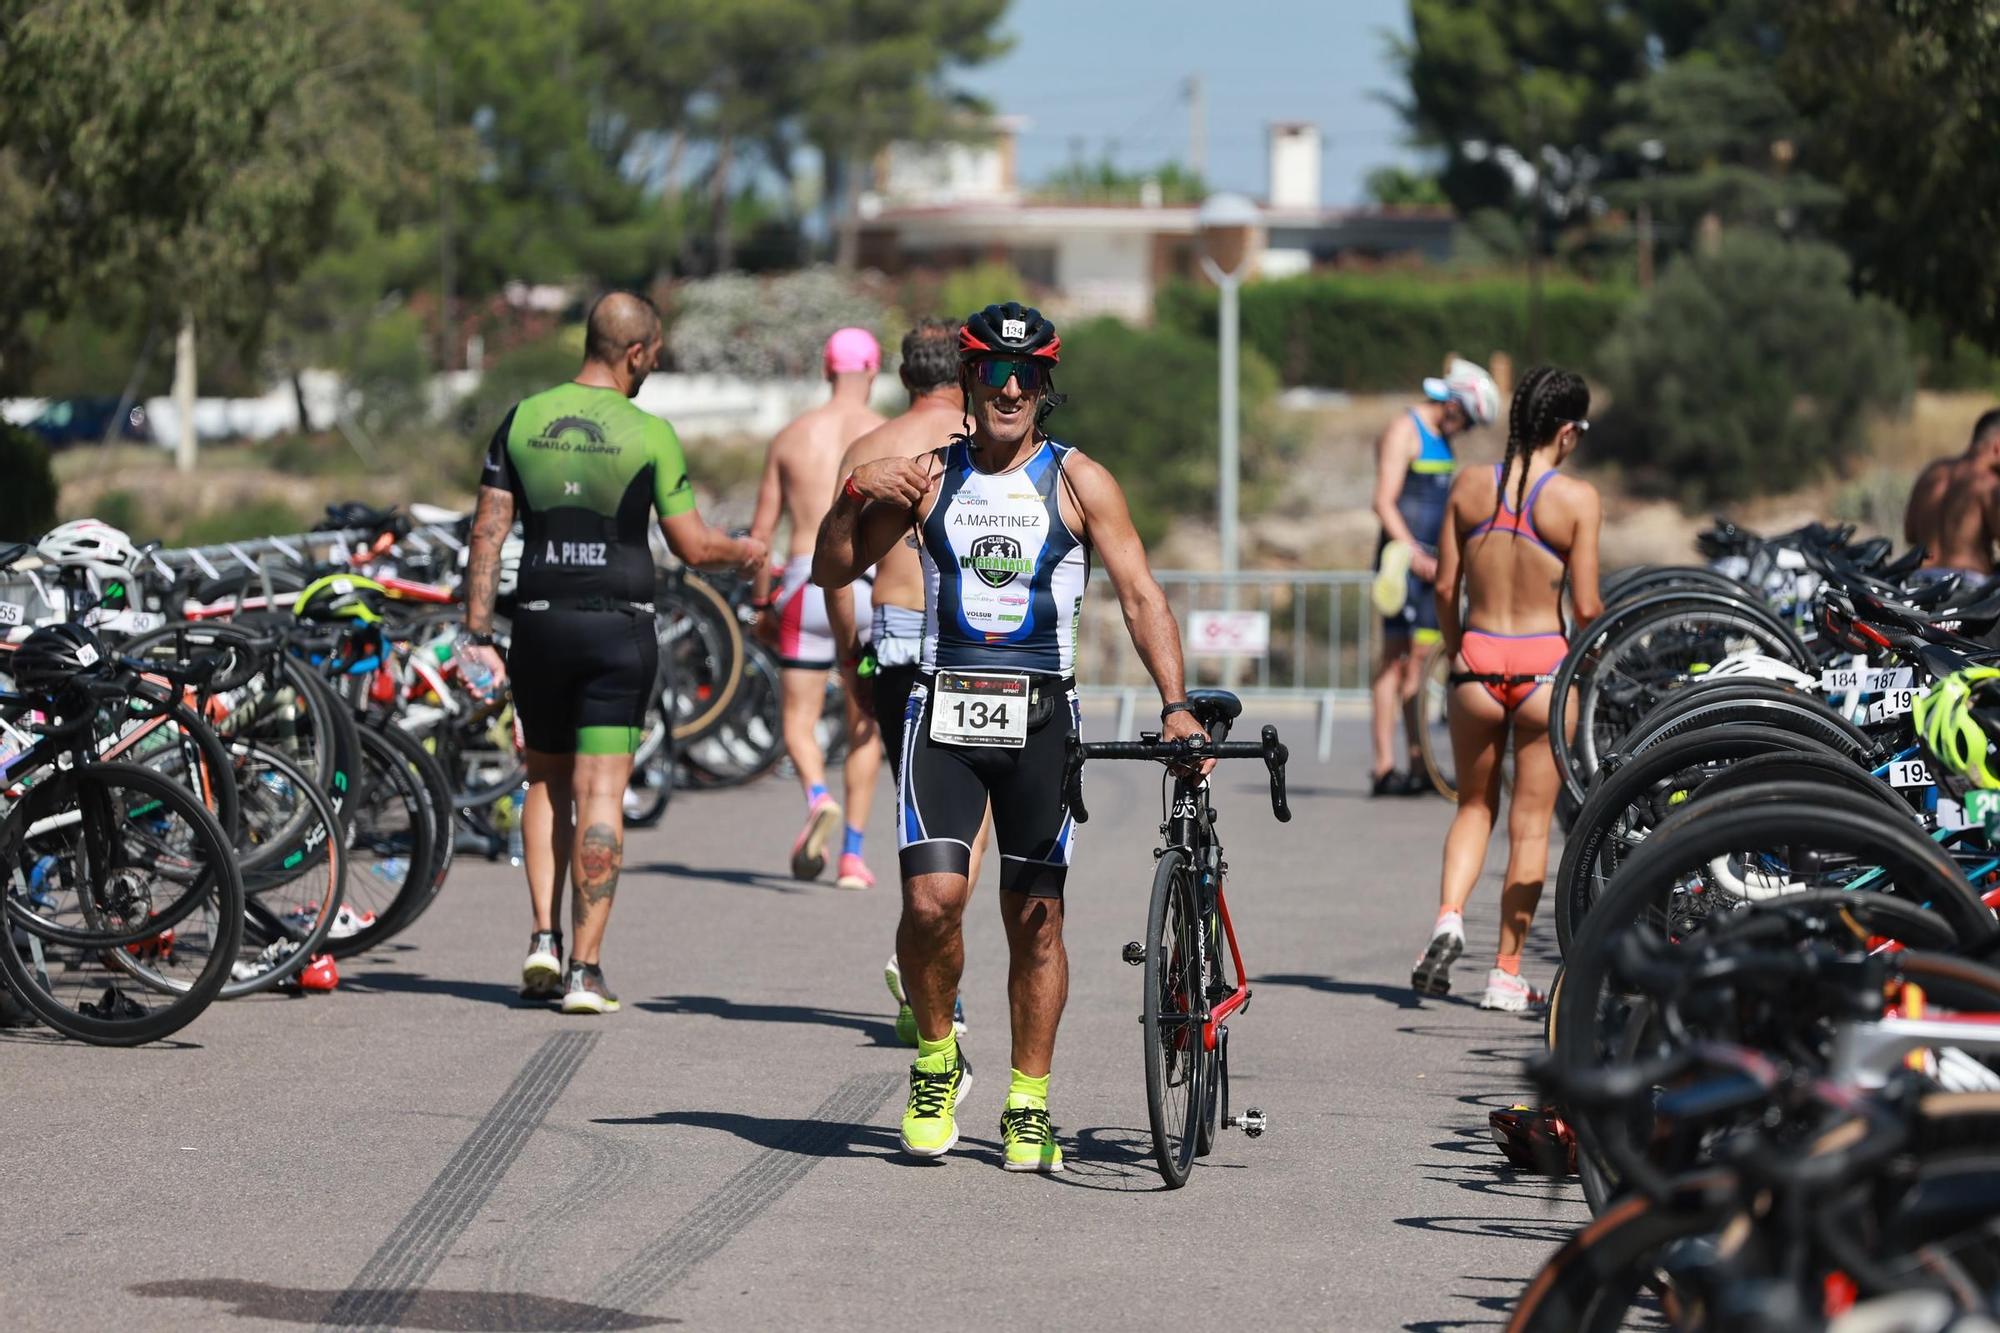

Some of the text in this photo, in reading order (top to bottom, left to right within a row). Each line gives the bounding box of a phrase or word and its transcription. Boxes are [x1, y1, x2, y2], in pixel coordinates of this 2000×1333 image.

[1005, 326, 1023, 336] 134
[953, 513, 1040, 528] A.MARTINEZ
[987, 536, 1005, 544] CLUB
[545, 540, 559, 565] A.
[132, 614, 149, 632] 50
[1831, 672, 1857, 687] 184
[1873, 672, 1897, 690] 187
[1893, 691, 1919, 709] 19
[953, 701, 1009, 730] 134
